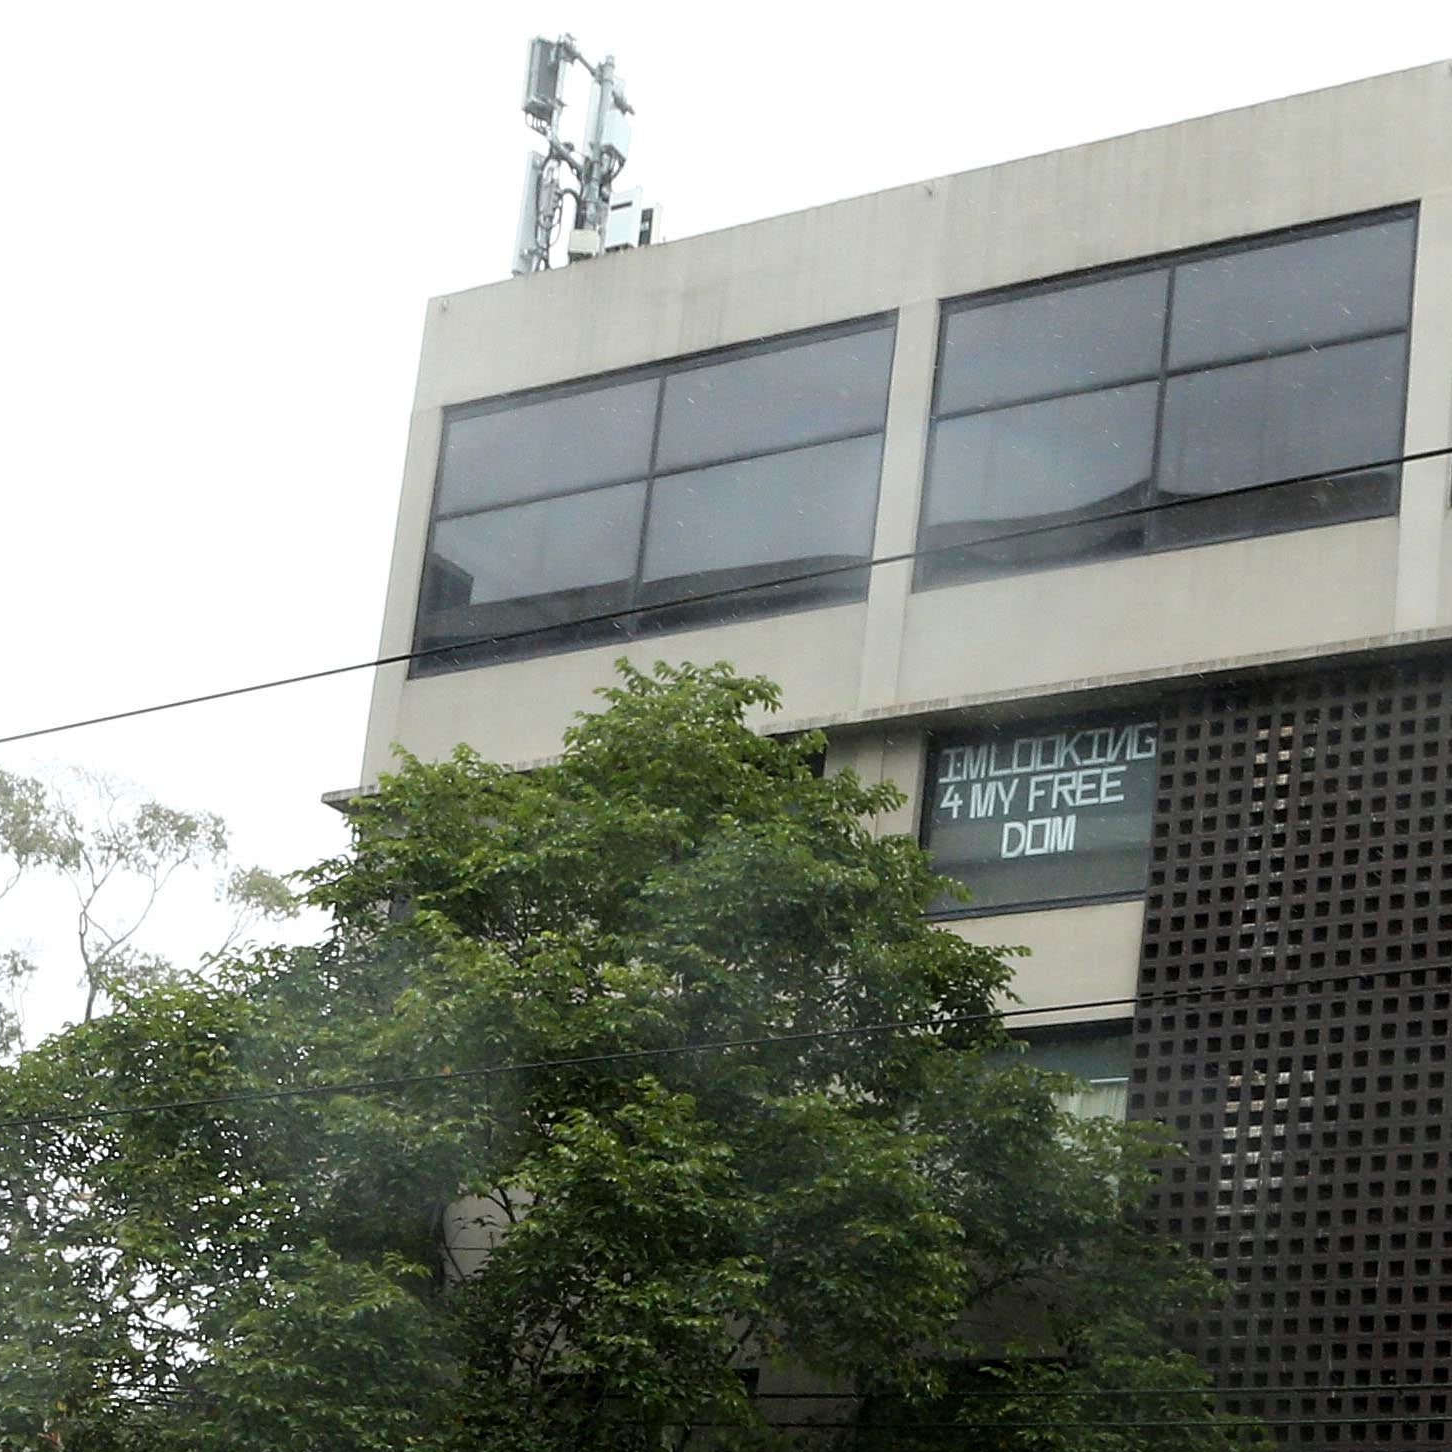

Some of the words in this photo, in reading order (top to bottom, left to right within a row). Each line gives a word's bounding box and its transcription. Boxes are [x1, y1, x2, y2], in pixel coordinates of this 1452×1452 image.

[988, 722, 1158, 777] LOOKING
[940, 785, 964, 819] 4
[969, 778, 1020, 819] MY
[1028, 765, 1127, 812] FREE
[1001, 814, 1077, 859] DOM
